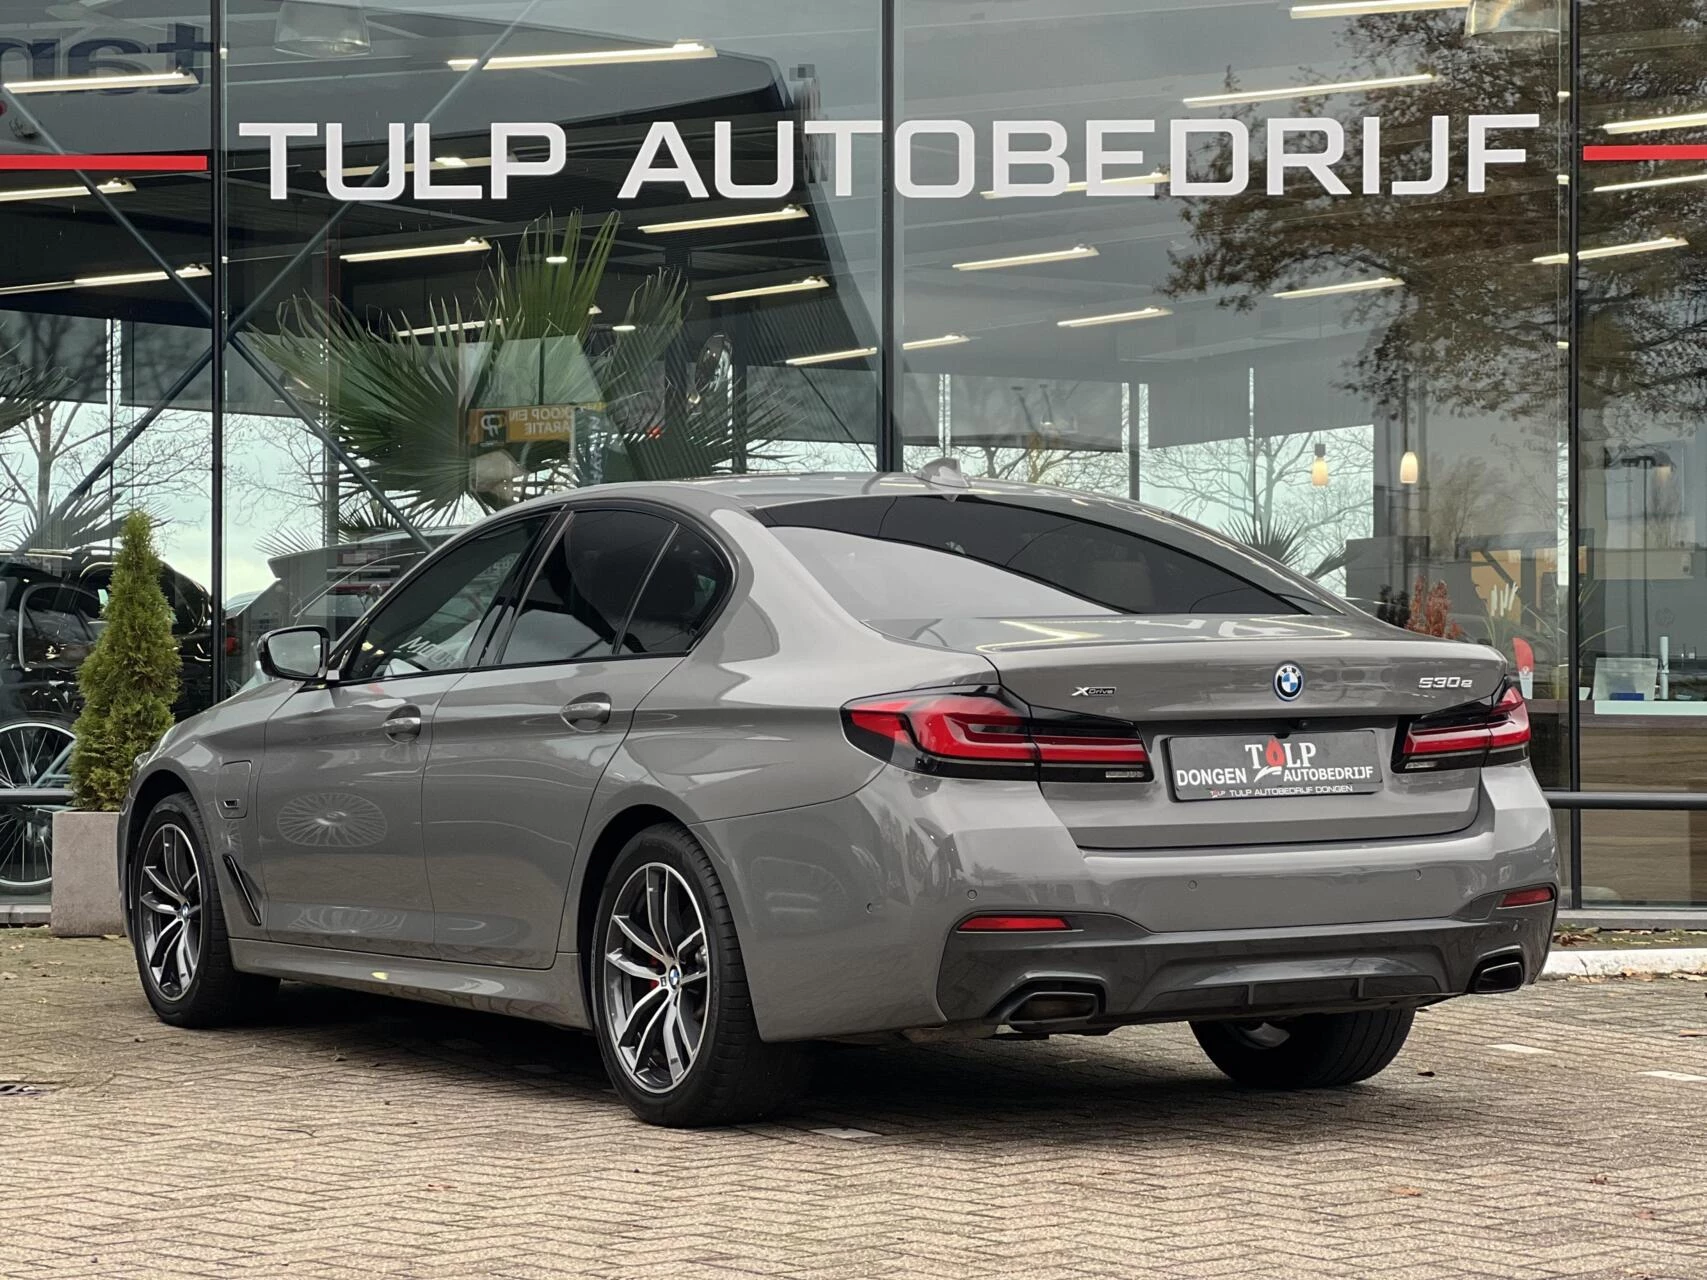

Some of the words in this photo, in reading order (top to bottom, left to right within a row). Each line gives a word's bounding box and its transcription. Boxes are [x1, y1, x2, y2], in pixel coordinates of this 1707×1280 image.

[238, 122, 567, 201] TULP
[616, 113, 1540, 200] AUTOBEDRIJF
[1418, 676, 1473, 689] 530e
[1176, 768, 1247, 787] DONGEN
[1283, 766, 1374, 783] AUTOBEDRIJF
[1229, 789, 1252, 797] TULP
[1254, 786, 1313, 797] AUTOBEDRIJF
[1315, 784, 1354, 794] DONGEN
